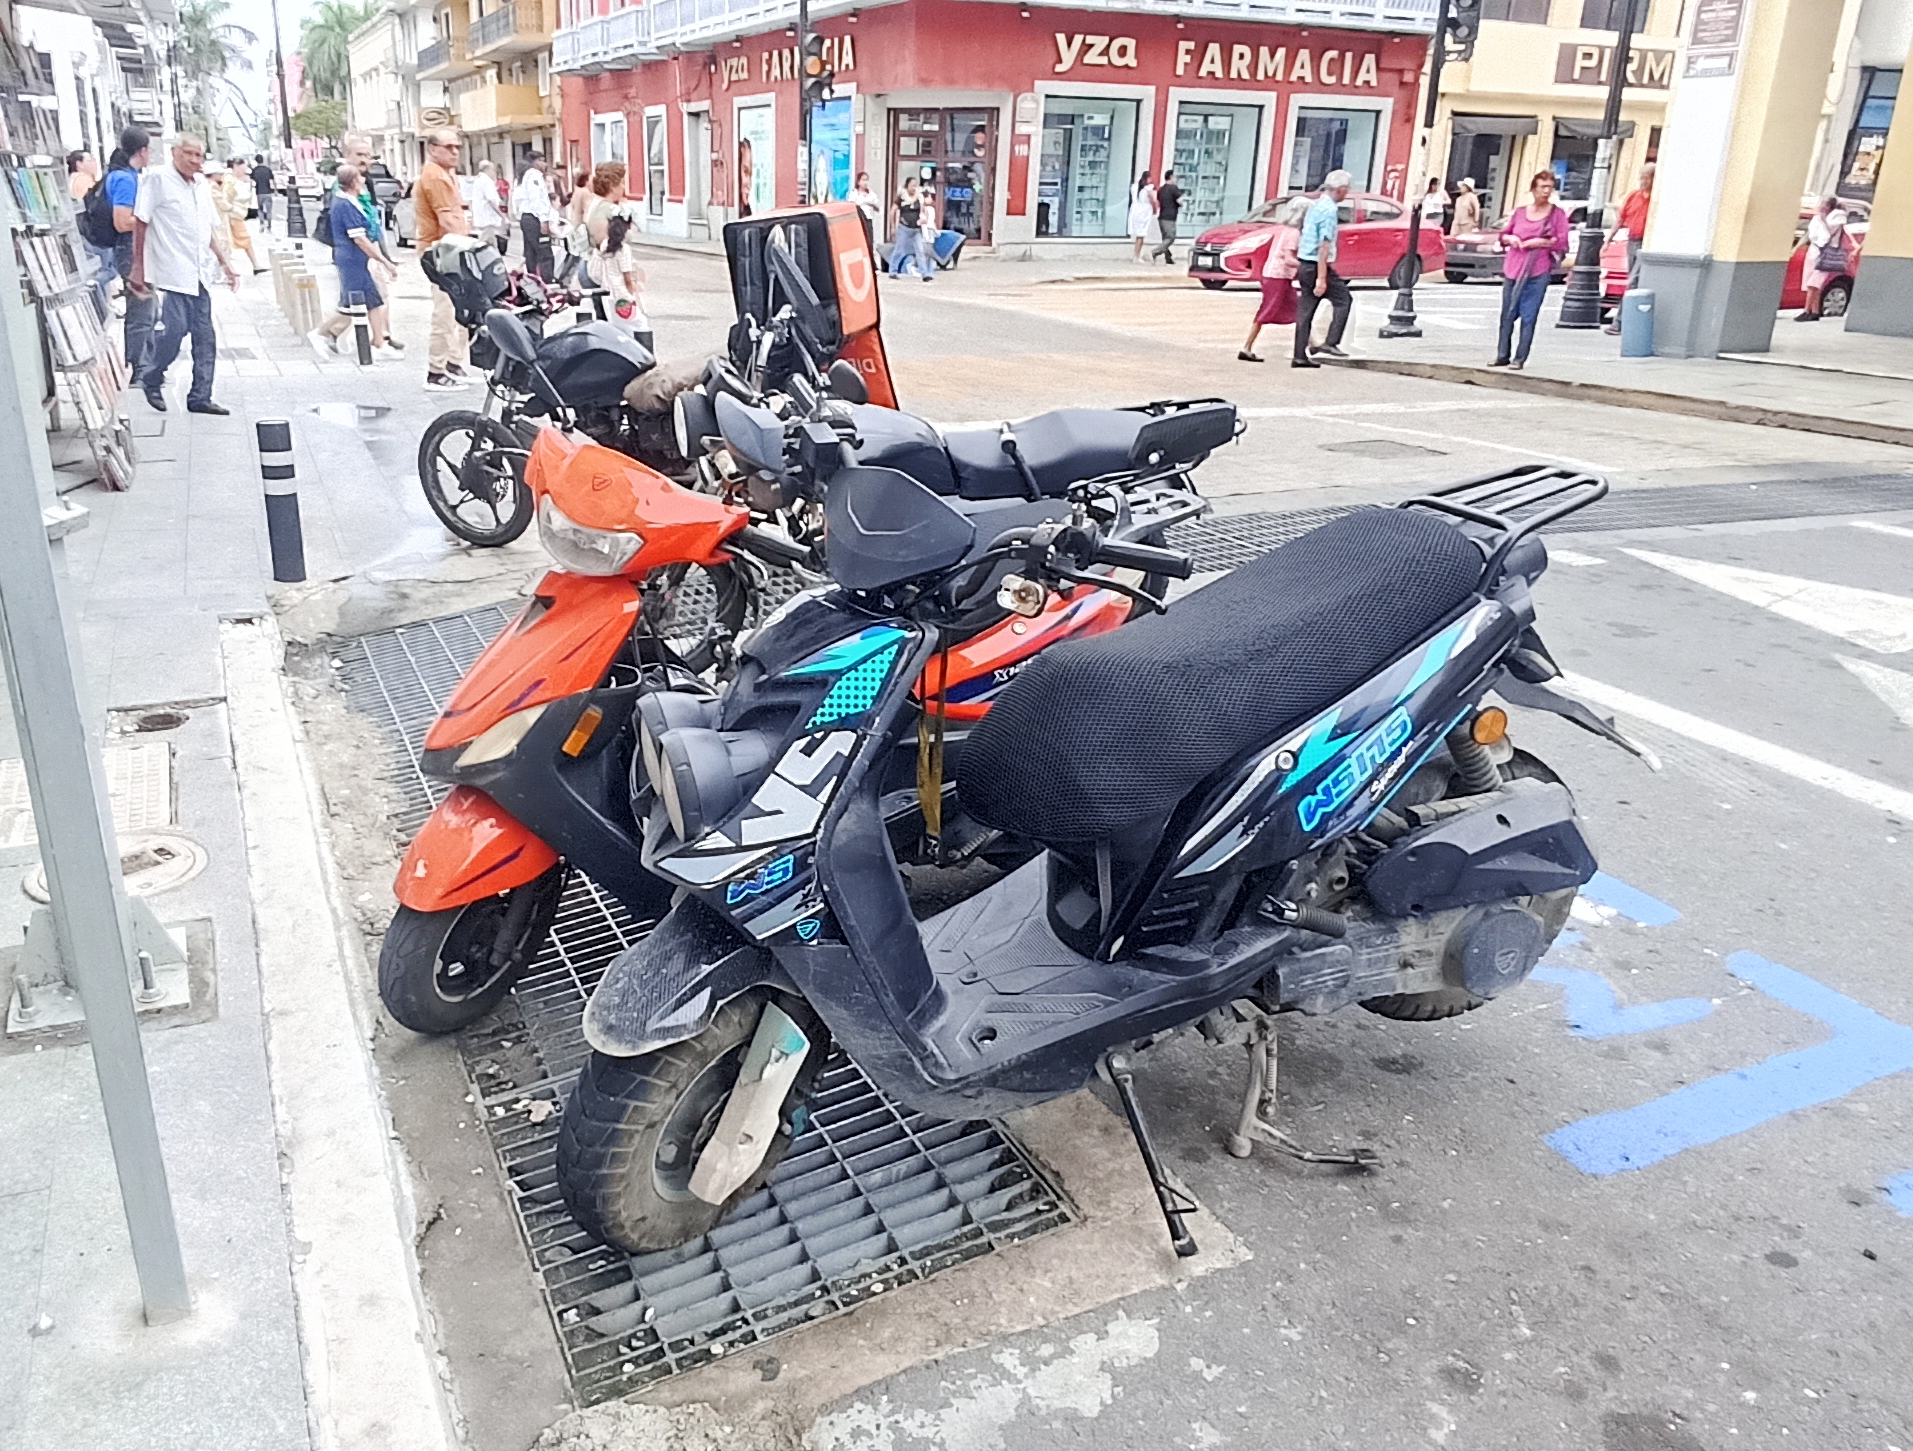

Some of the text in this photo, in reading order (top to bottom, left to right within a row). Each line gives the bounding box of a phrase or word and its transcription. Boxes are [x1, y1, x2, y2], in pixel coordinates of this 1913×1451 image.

[721, 35, 854, 91] yza FARCIA
[1054, 32, 1378, 87] yza FARMACIA
